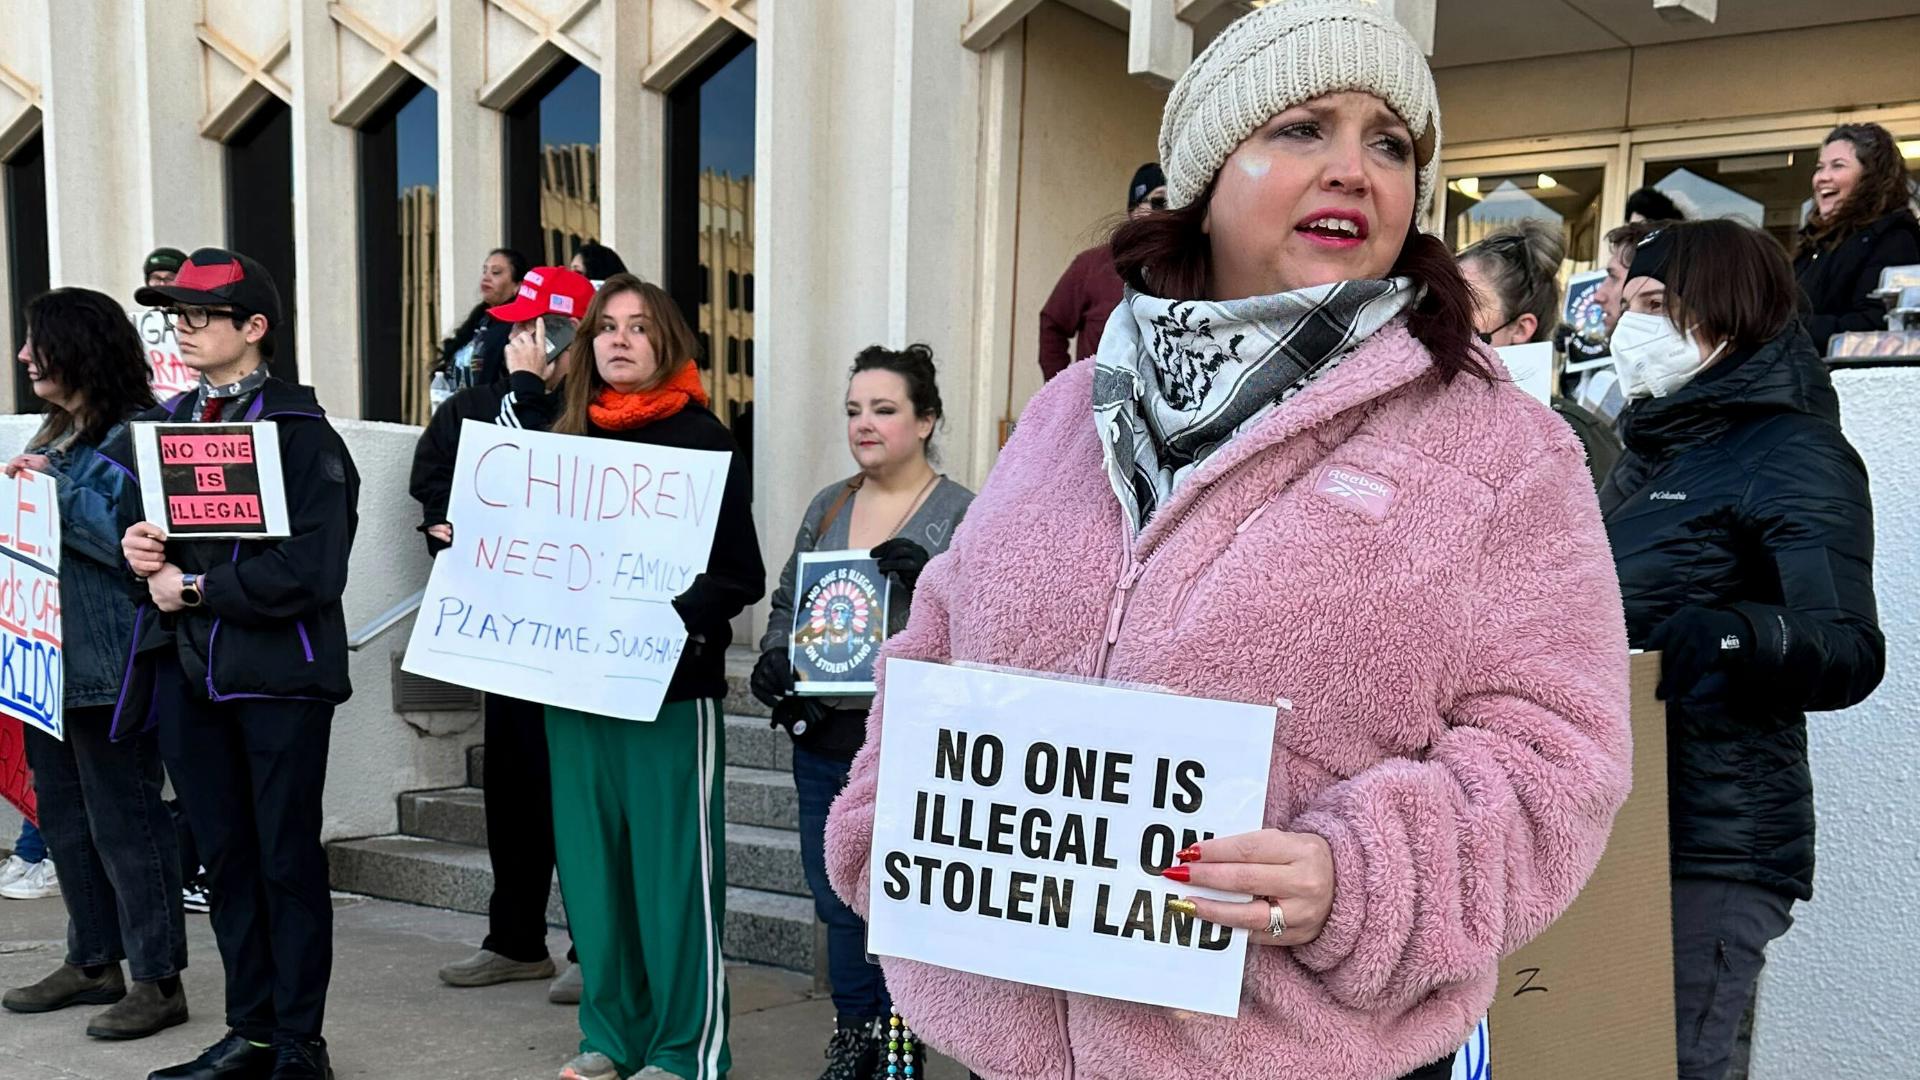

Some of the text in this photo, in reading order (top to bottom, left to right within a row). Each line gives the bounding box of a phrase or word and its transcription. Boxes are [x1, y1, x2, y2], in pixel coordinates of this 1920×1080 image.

[164, 441, 251, 459] NO ONE
[198, 472, 223, 487] IS
[1328, 469, 1389, 497] Reebok
[171, 502, 259, 519] ILLEGAL
[475, 535, 692, 593] NEED: FAMILY
[808, 567, 877, 601] NO ONE IS ILLEGAL
[434, 596, 601, 654] PLAYTIME,
[805, 643, 872, 674] ON STOLEN LAND
[935, 727, 1206, 814] NO ONE IS
[913, 789, 1118, 870] ILLEGAL
[883, 850, 1074, 929] STOLEN
